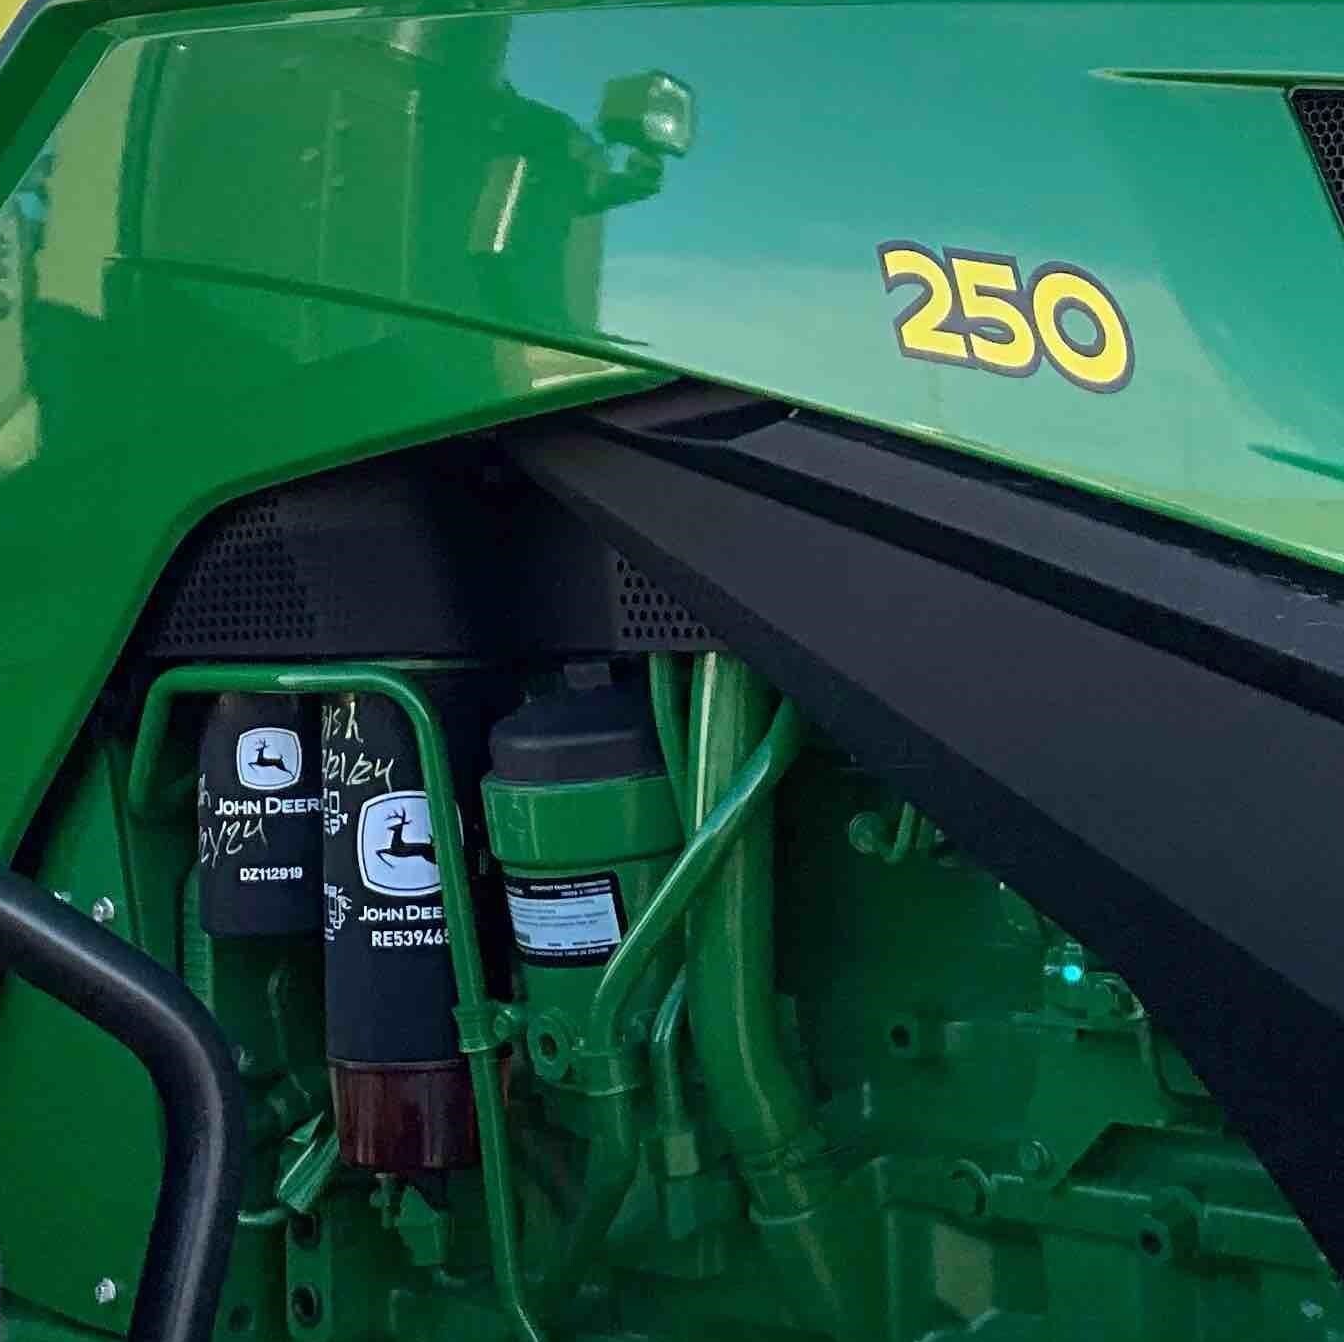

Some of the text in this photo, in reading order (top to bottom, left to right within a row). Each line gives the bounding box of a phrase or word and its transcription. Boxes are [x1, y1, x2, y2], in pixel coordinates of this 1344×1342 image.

[876, 239, 1136, 395] 250
[215, 797, 323, 815] JOHN DEER
[358, 905, 445, 921] JOHN DEE
